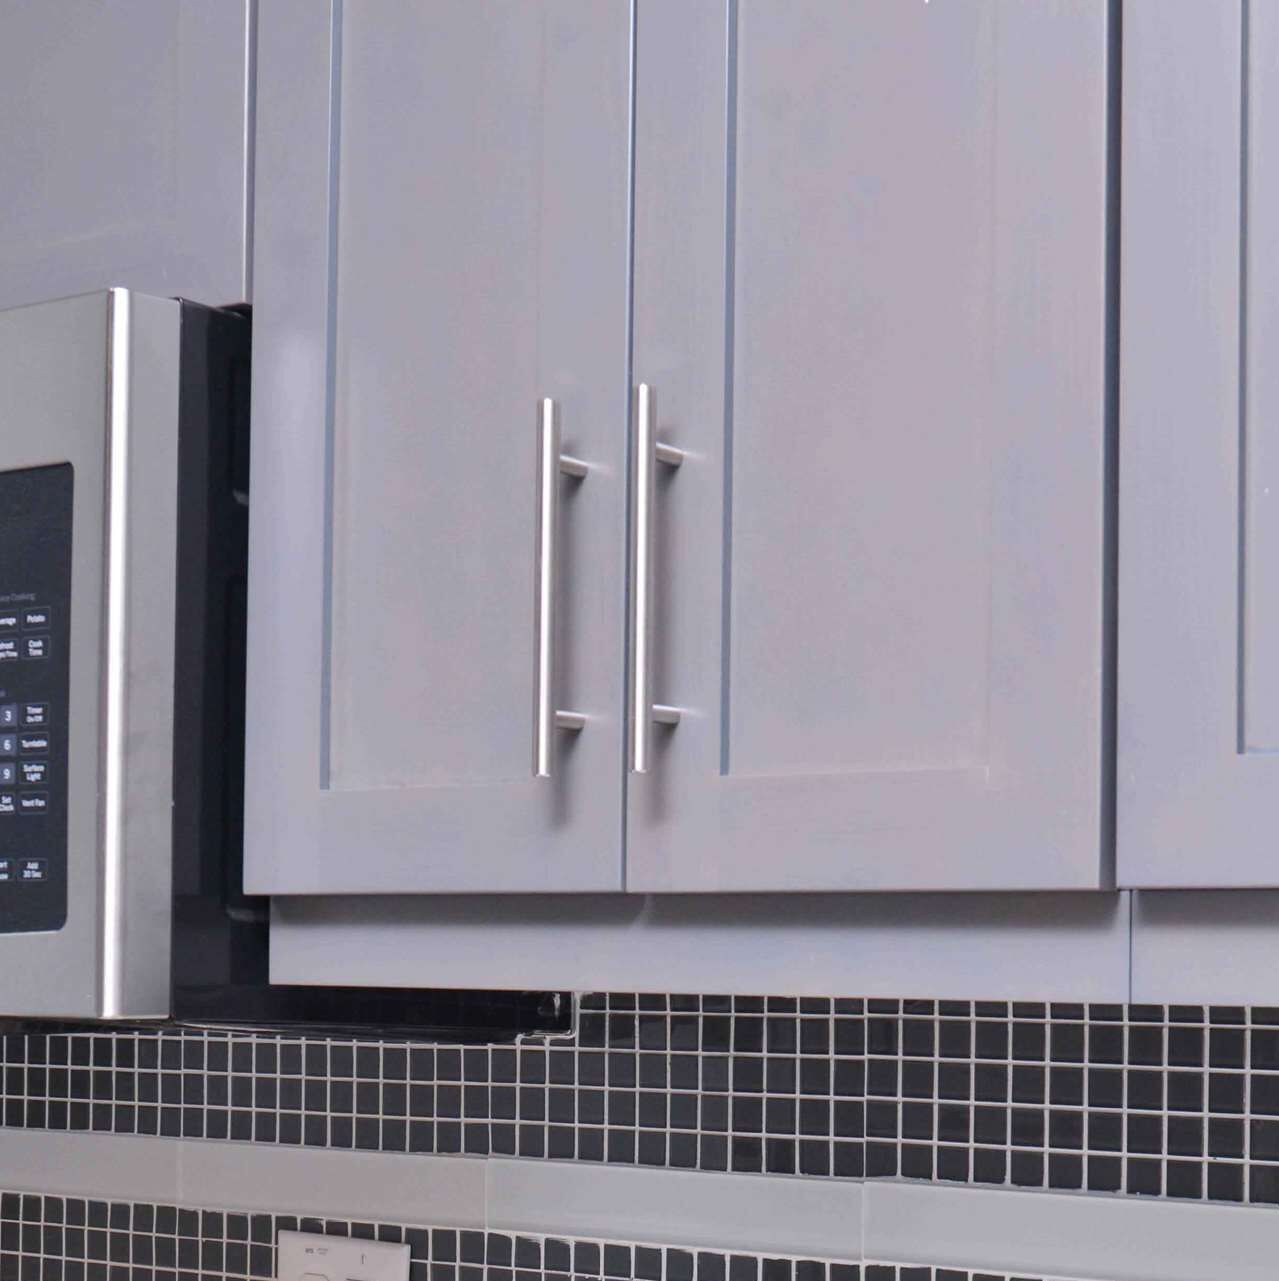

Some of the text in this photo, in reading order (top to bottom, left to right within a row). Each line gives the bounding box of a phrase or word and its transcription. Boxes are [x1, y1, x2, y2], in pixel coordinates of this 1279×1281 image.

[4, 710, 12, 722] 3
[3, 739, 11, 751] 6
[3, 768, 11, 779] 9
